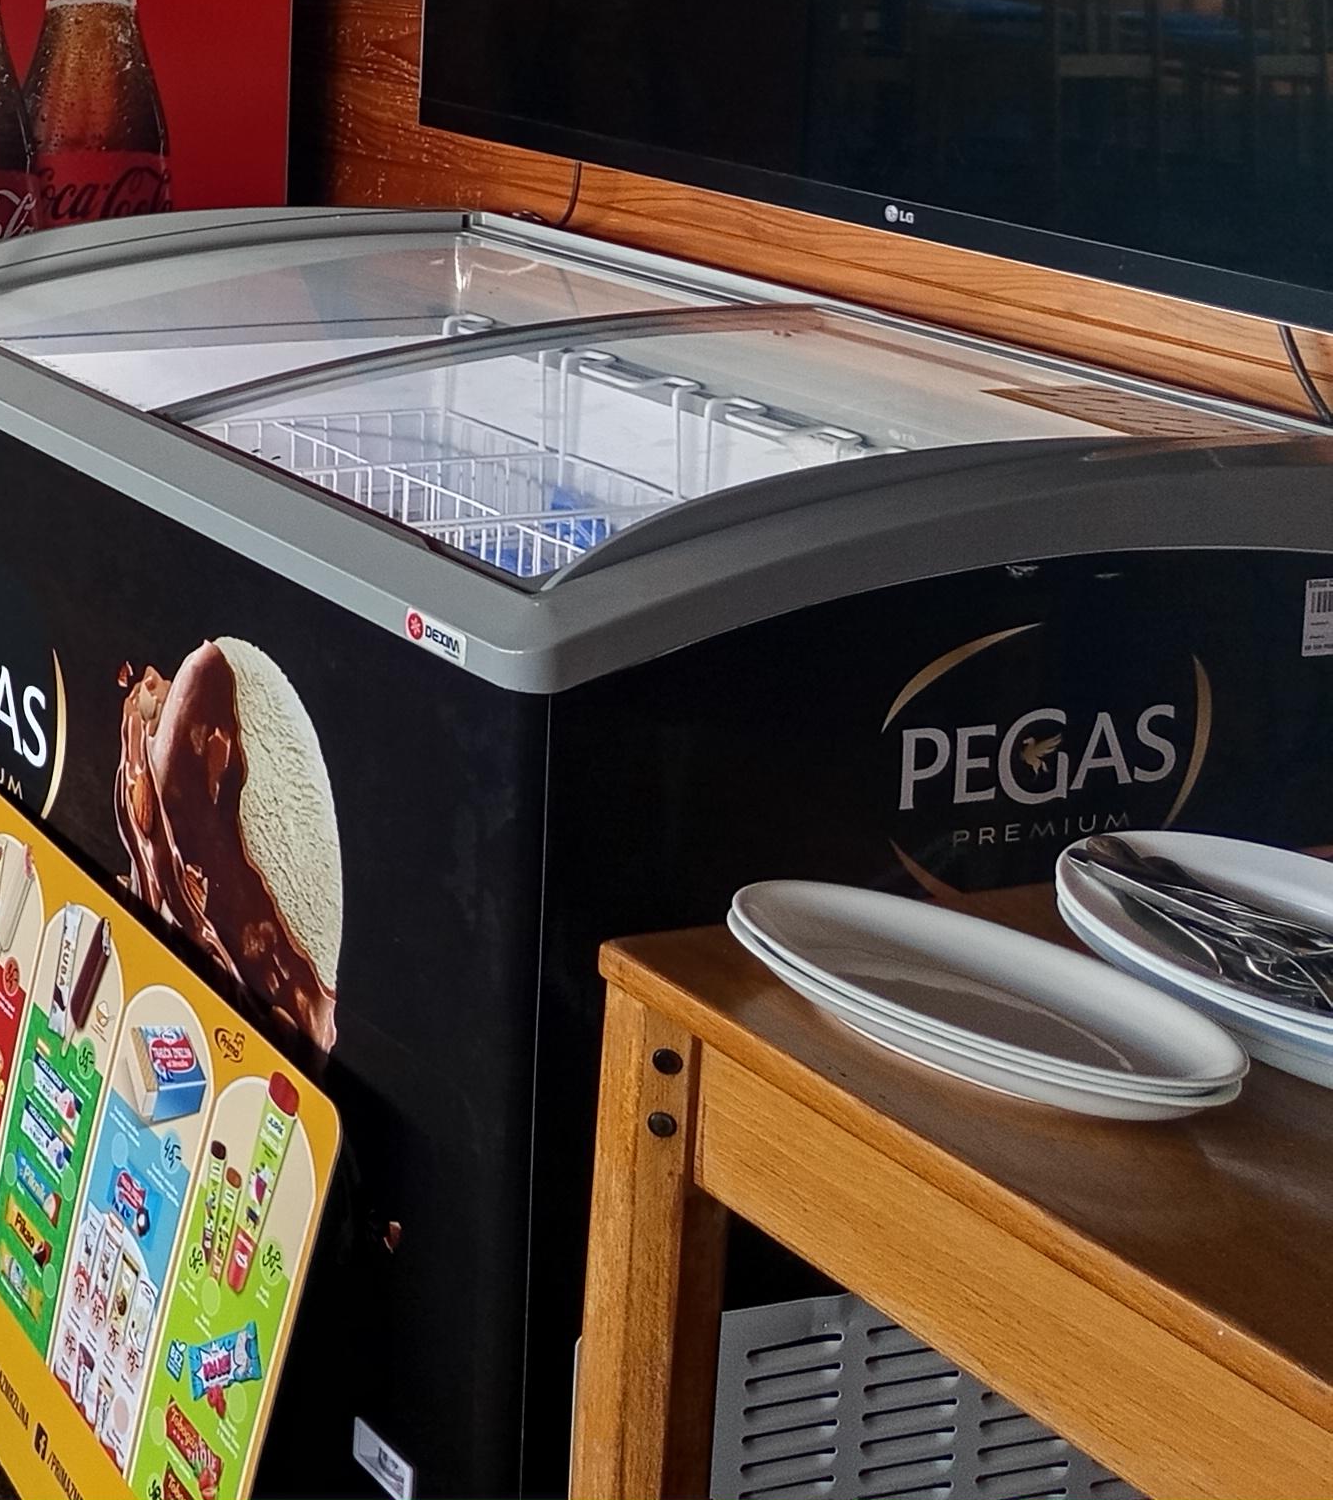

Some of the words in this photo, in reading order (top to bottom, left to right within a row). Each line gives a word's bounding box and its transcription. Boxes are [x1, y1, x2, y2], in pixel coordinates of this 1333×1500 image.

[899, 210, 914, 224] LG
[898, 704, 1179, 810] PEGAS
[952, 811, 1132, 847] PREMIUM
[58, 941, 72, 988] KUBA
[15, 1212, 34, 1248] Pikao
